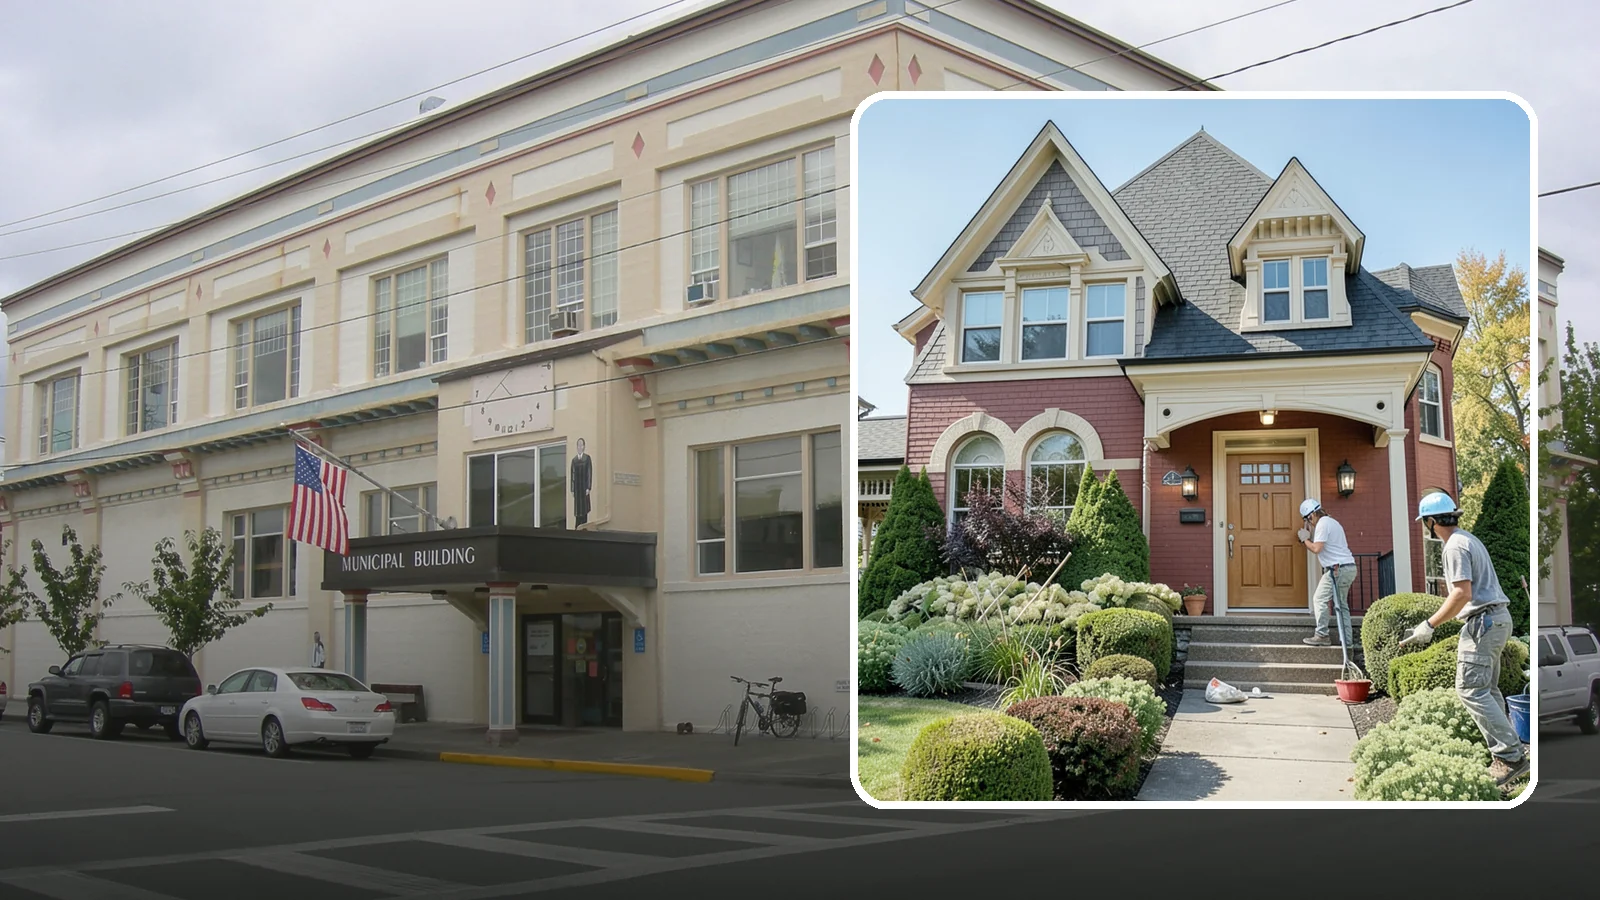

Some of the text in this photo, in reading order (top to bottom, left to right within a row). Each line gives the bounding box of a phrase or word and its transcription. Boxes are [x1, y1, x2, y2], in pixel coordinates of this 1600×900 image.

[480, 406, 485, 415] 8
[487, 417, 492, 426] 9
[507, 425, 514, 434] 12
[521, 420, 526, 428] 2
[528, 413, 533, 422] 3
[536, 402, 540, 410] 4
[342, 546, 475, 571] MUNICIPAL BUILDING
